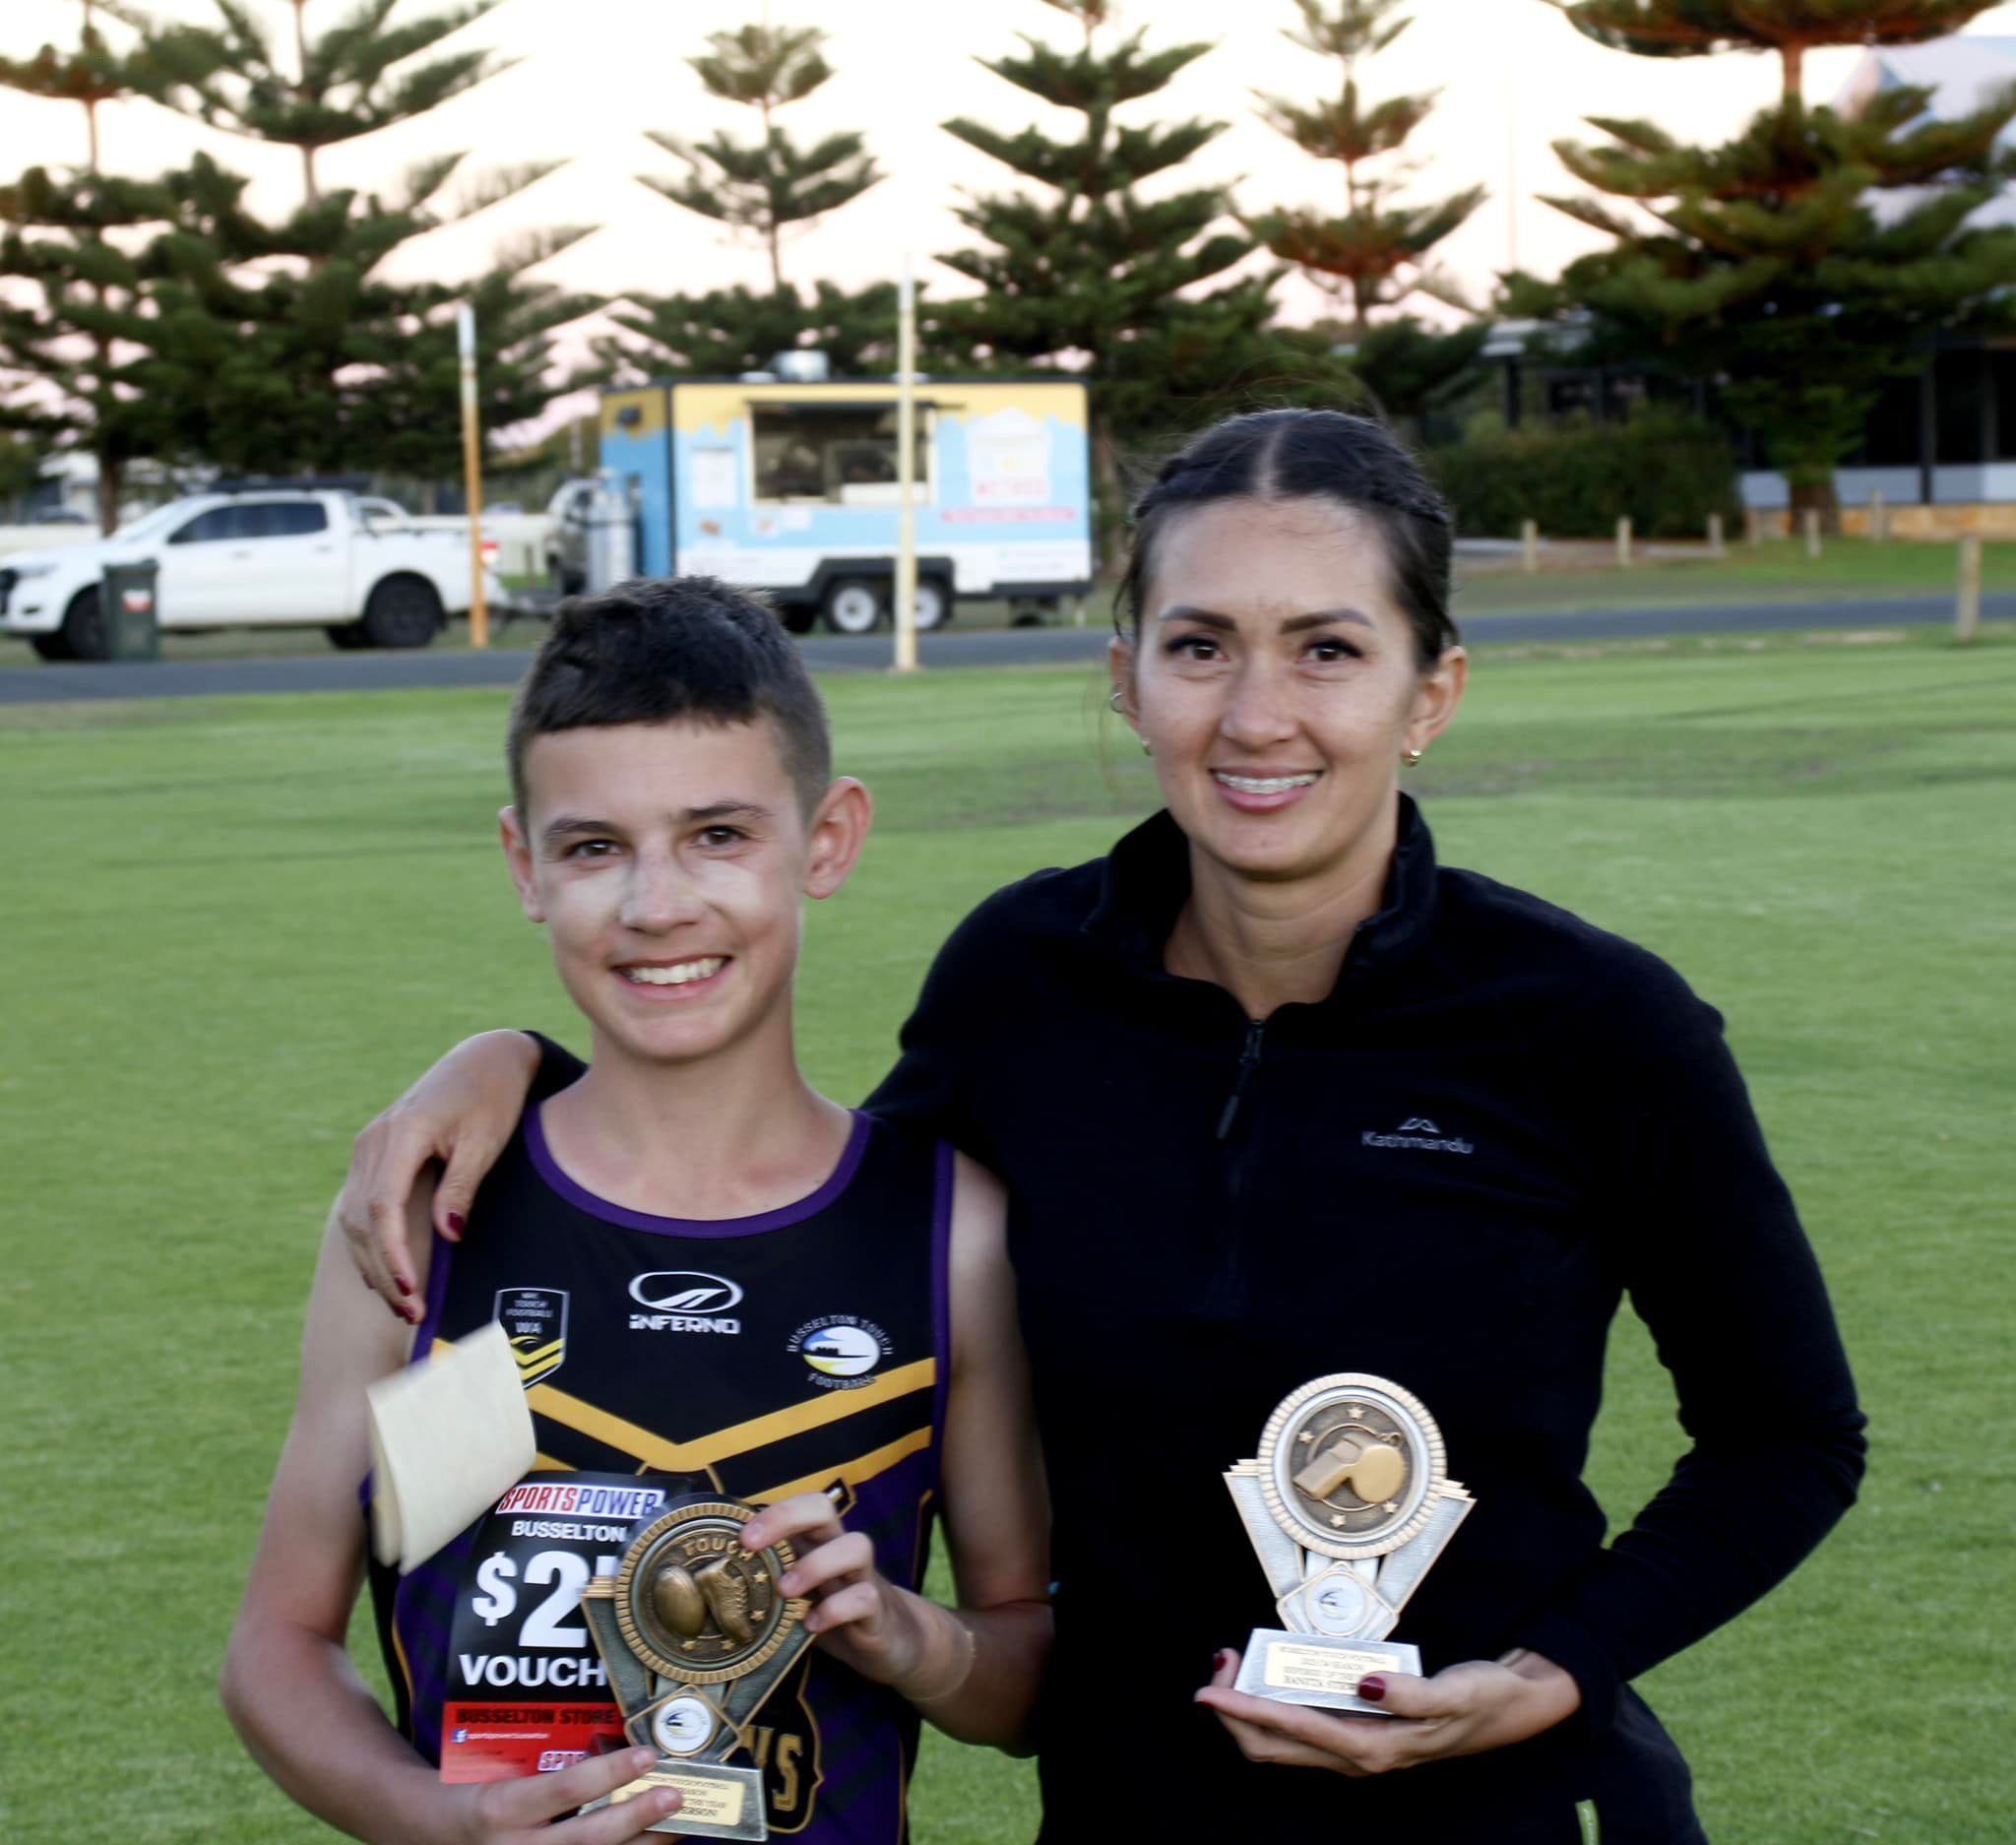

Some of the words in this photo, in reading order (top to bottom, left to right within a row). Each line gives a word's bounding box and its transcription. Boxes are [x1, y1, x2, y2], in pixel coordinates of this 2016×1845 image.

[1361, 1131, 1474, 1154] Kathmandu
[786, 1315, 857, 1353] BUSSELTON
[859, 1319, 894, 1355] TOUCH
[499, 1487, 658, 1517] SPORTSPOWER
[511, 1520, 627, 1542] BUSSELTON
[472, 1551, 618, 1649] $2
[458, 1654, 609, 1686] VOUCH
[457, 1708, 554, 1724] BUSSELTON
[560, 1709, 616, 1725] STORE
